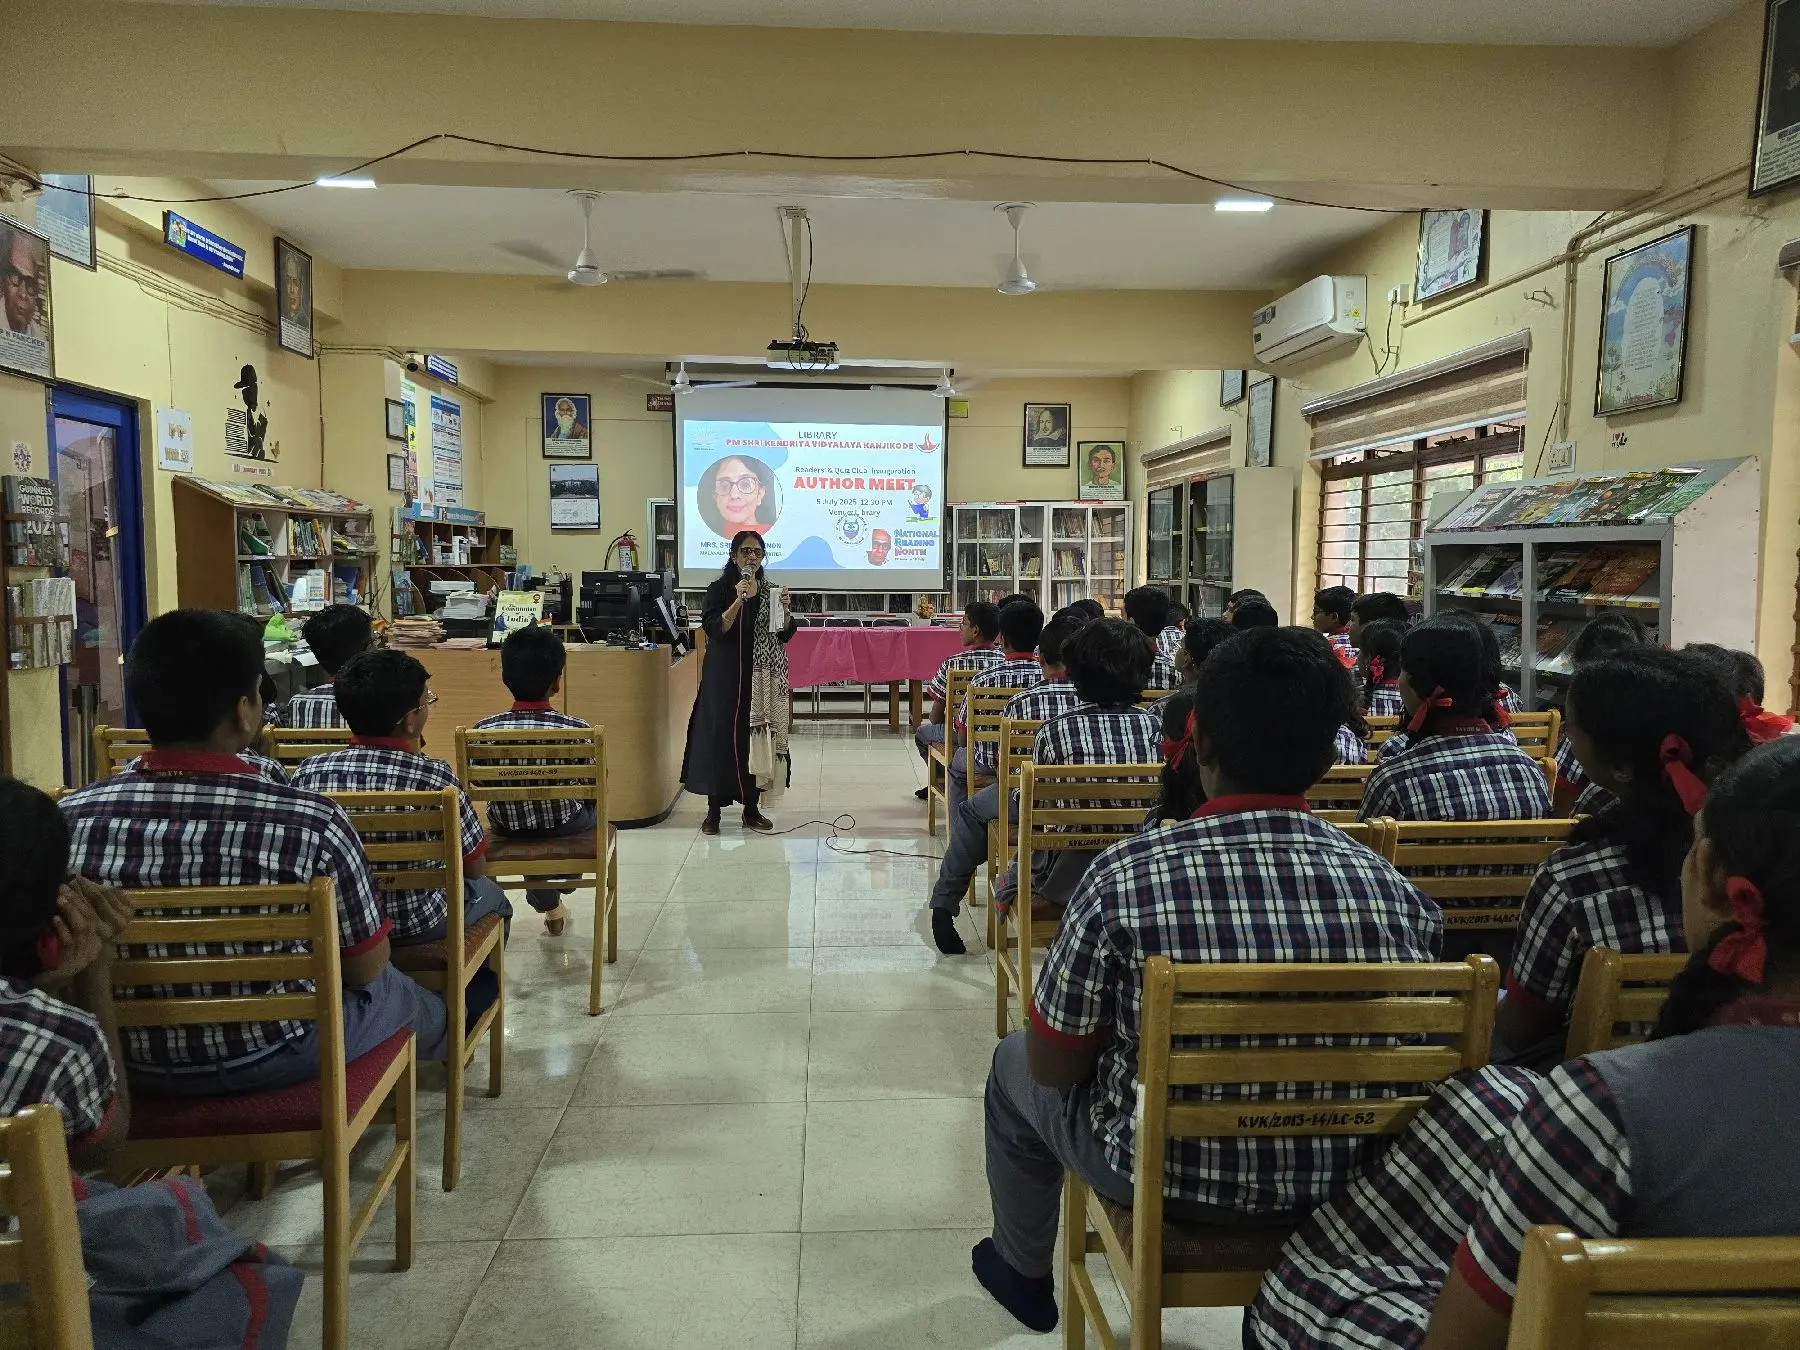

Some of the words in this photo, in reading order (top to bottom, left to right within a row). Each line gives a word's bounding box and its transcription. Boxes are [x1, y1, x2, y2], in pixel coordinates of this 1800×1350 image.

[798, 431, 838, 440] LIBRARY
[742, 439, 763, 447] SHRI
[812, 440, 862, 449] VIDYALAYA
[863, 441, 914, 450] KANJIKODE
[834, 467, 851, 475] Quiz
[851, 467, 868, 475] Club
[871, 467, 916, 476] Inauguration
[794, 477, 865, 490] AUTHOR
[868, 478, 916, 491] MEET
[20, 484, 53, 496] GUINNESS
[21, 494, 54, 508] WORLD
[21, 505, 55, 516] RECORDS
[894, 529, 939, 538] NATIONAL
[894, 538, 935, 547] READING
[894, 547, 927, 556] MONTH
[506, 615, 529, 623] India
[1237, 1111, 1375, 1129] KVK/2013-14/LC-52
